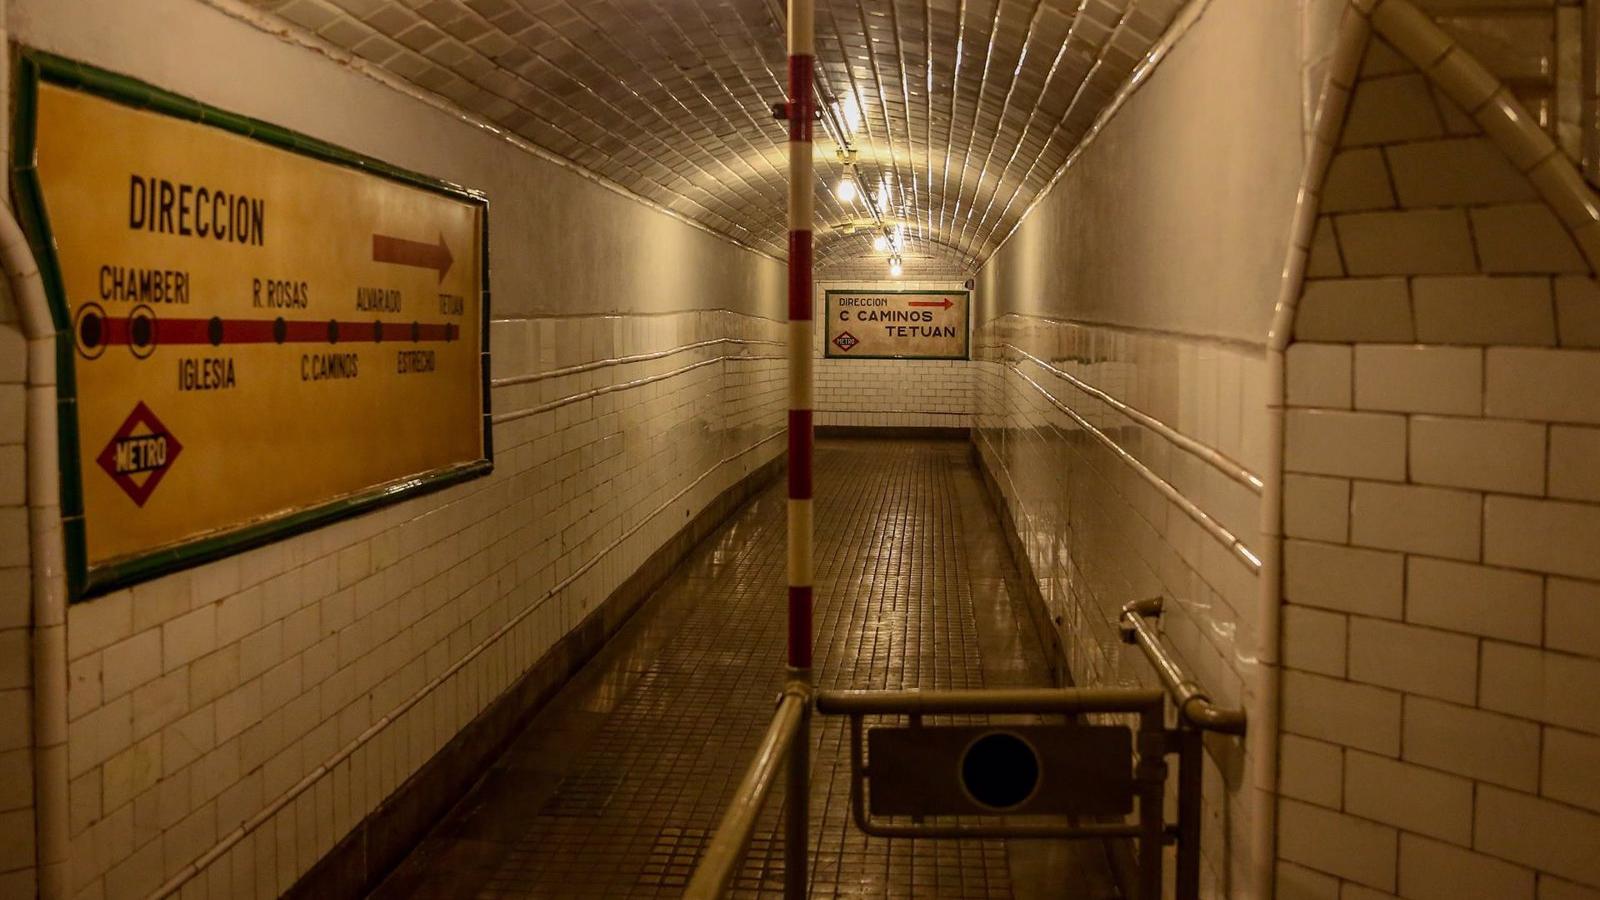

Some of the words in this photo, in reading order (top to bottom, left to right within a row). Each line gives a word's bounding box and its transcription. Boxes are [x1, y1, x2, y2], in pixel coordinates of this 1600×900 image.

[129, 174, 264, 247] DIRECCION
[100, 265, 189, 304] CHAMBERI
[268, 280, 308, 309] ROSAS
[356, 287, 402, 313] ALVARADO
[839, 297, 888, 307] DIRECCION
[857, 310, 933, 322] CAMINOS
[885, 326, 956, 338] TETUAN
[178, 357, 236, 391] IGLESIA
[397, 350, 435, 374] ESTRECHO
[115, 437, 168, 473] METRO
